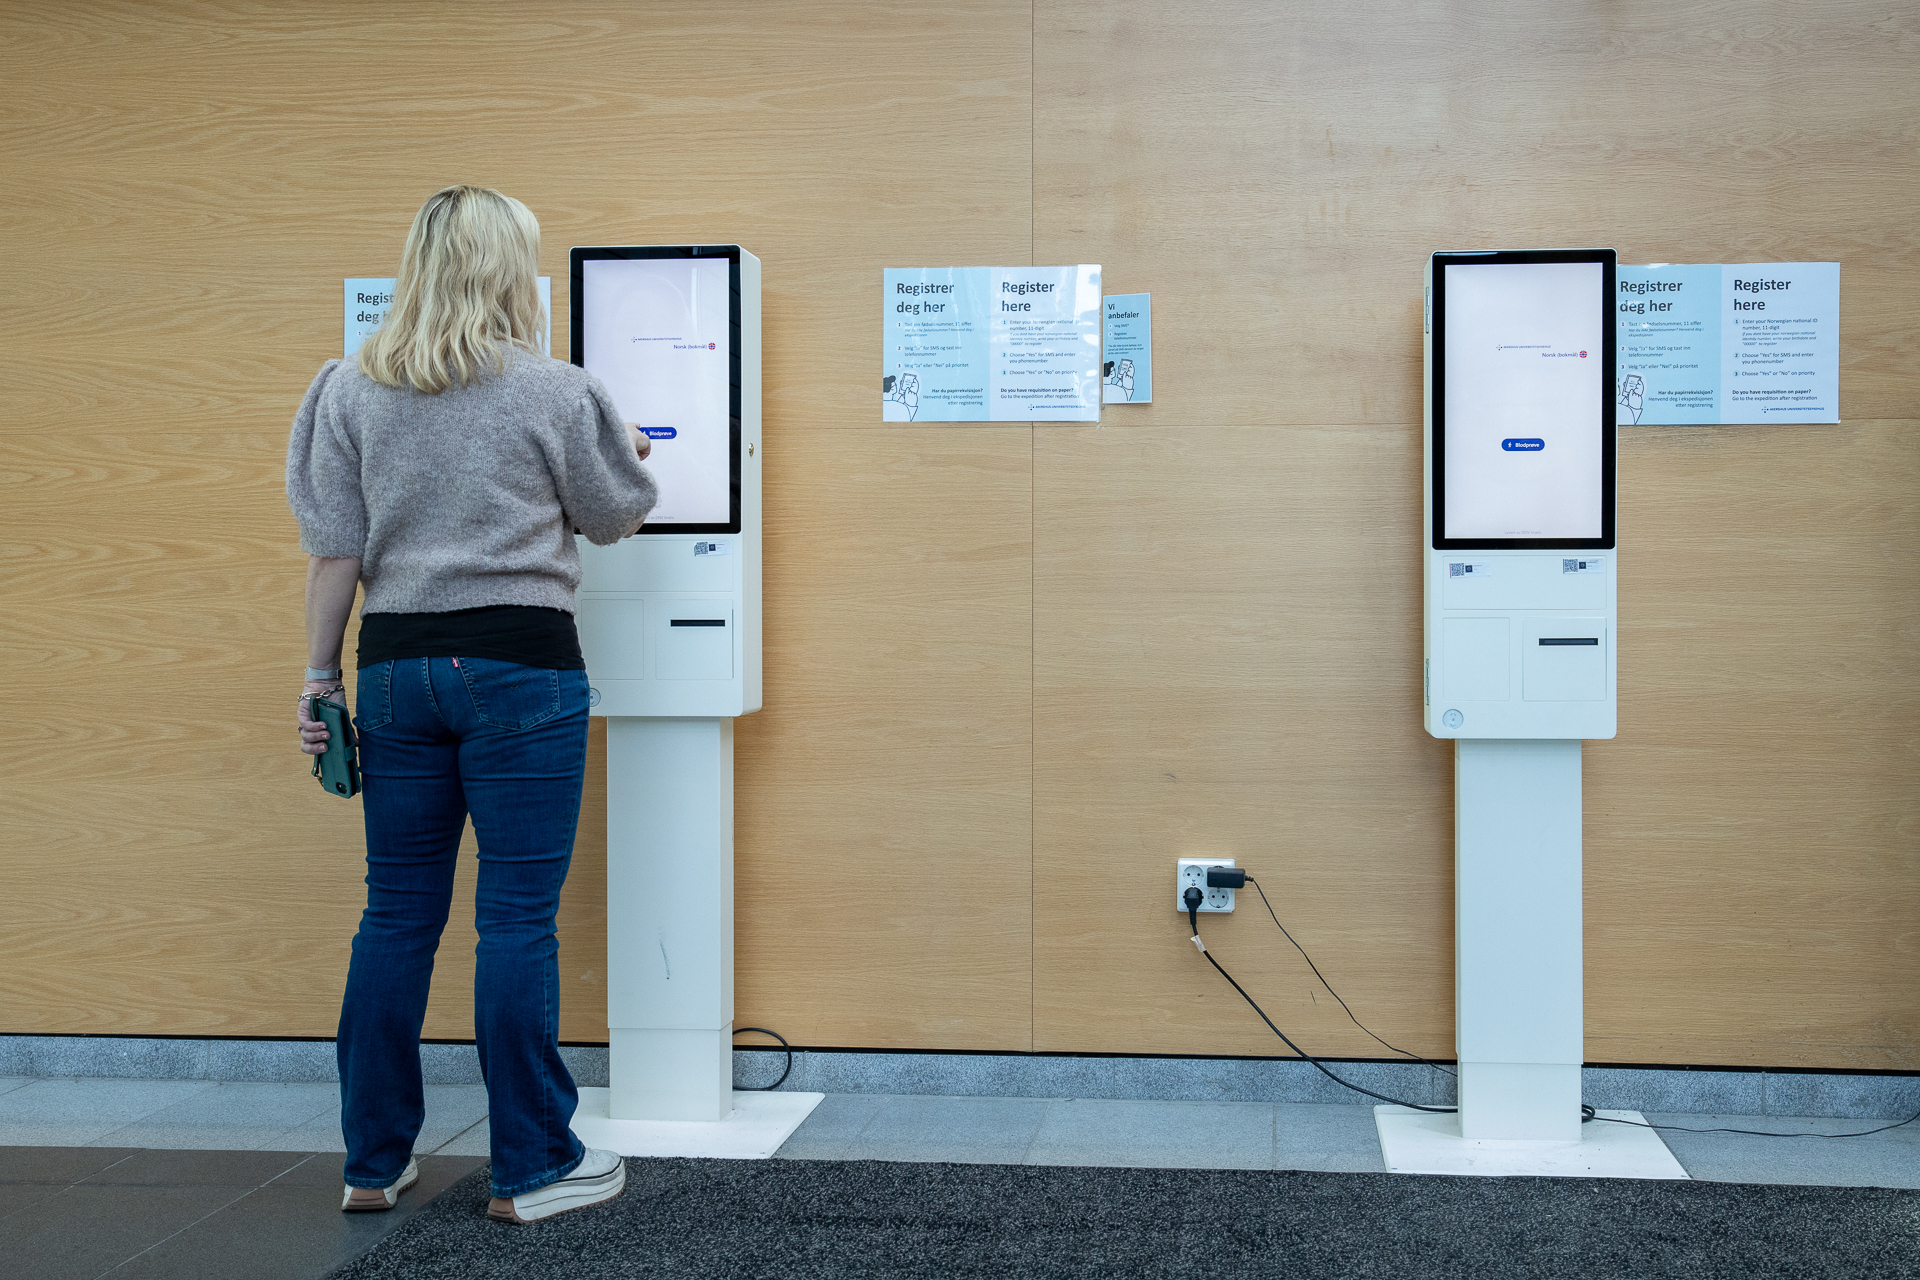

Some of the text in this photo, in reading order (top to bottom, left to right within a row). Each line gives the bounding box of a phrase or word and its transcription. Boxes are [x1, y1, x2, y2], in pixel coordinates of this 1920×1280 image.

[897, 282, 954, 296] Registrer
[1002, 281, 1054, 295] Register
[1621, 280, 1682, 294] Registrer
[1734, 279, 1791, 293] Register
[358, 292, 394, 306] Regist
[1002, 300, 1031, 311] here
[1734, 299, 1765, 310] here
[897, 301, 945, 315] deg her
[1620, 300, 1672, 314] deg her
[357, 311, 379, 324] deg
